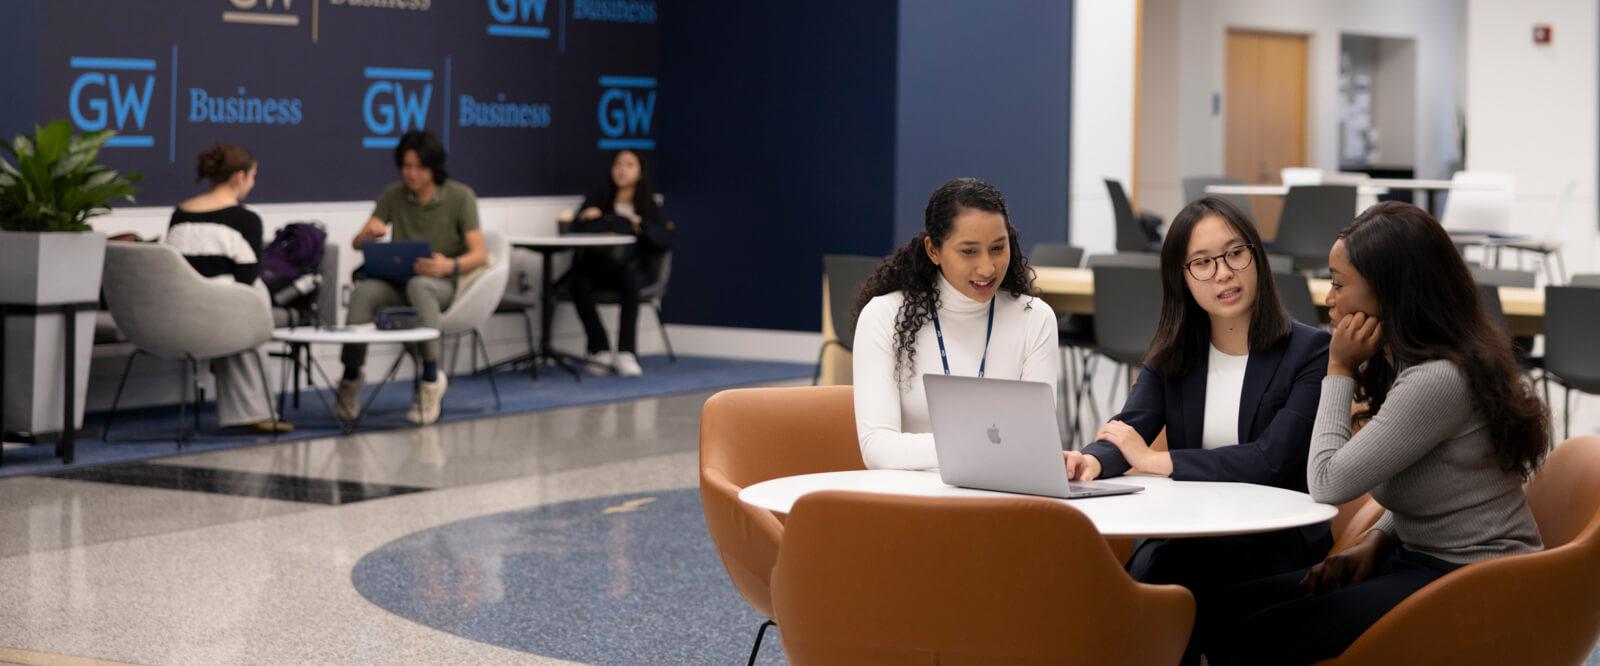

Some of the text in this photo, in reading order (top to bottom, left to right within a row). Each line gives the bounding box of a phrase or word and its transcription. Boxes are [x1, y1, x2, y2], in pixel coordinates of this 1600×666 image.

[69, 71, 302, 131] GW Business
[362, 80, 551, 134] GW Business
[597, 88, 656, 137] GW
